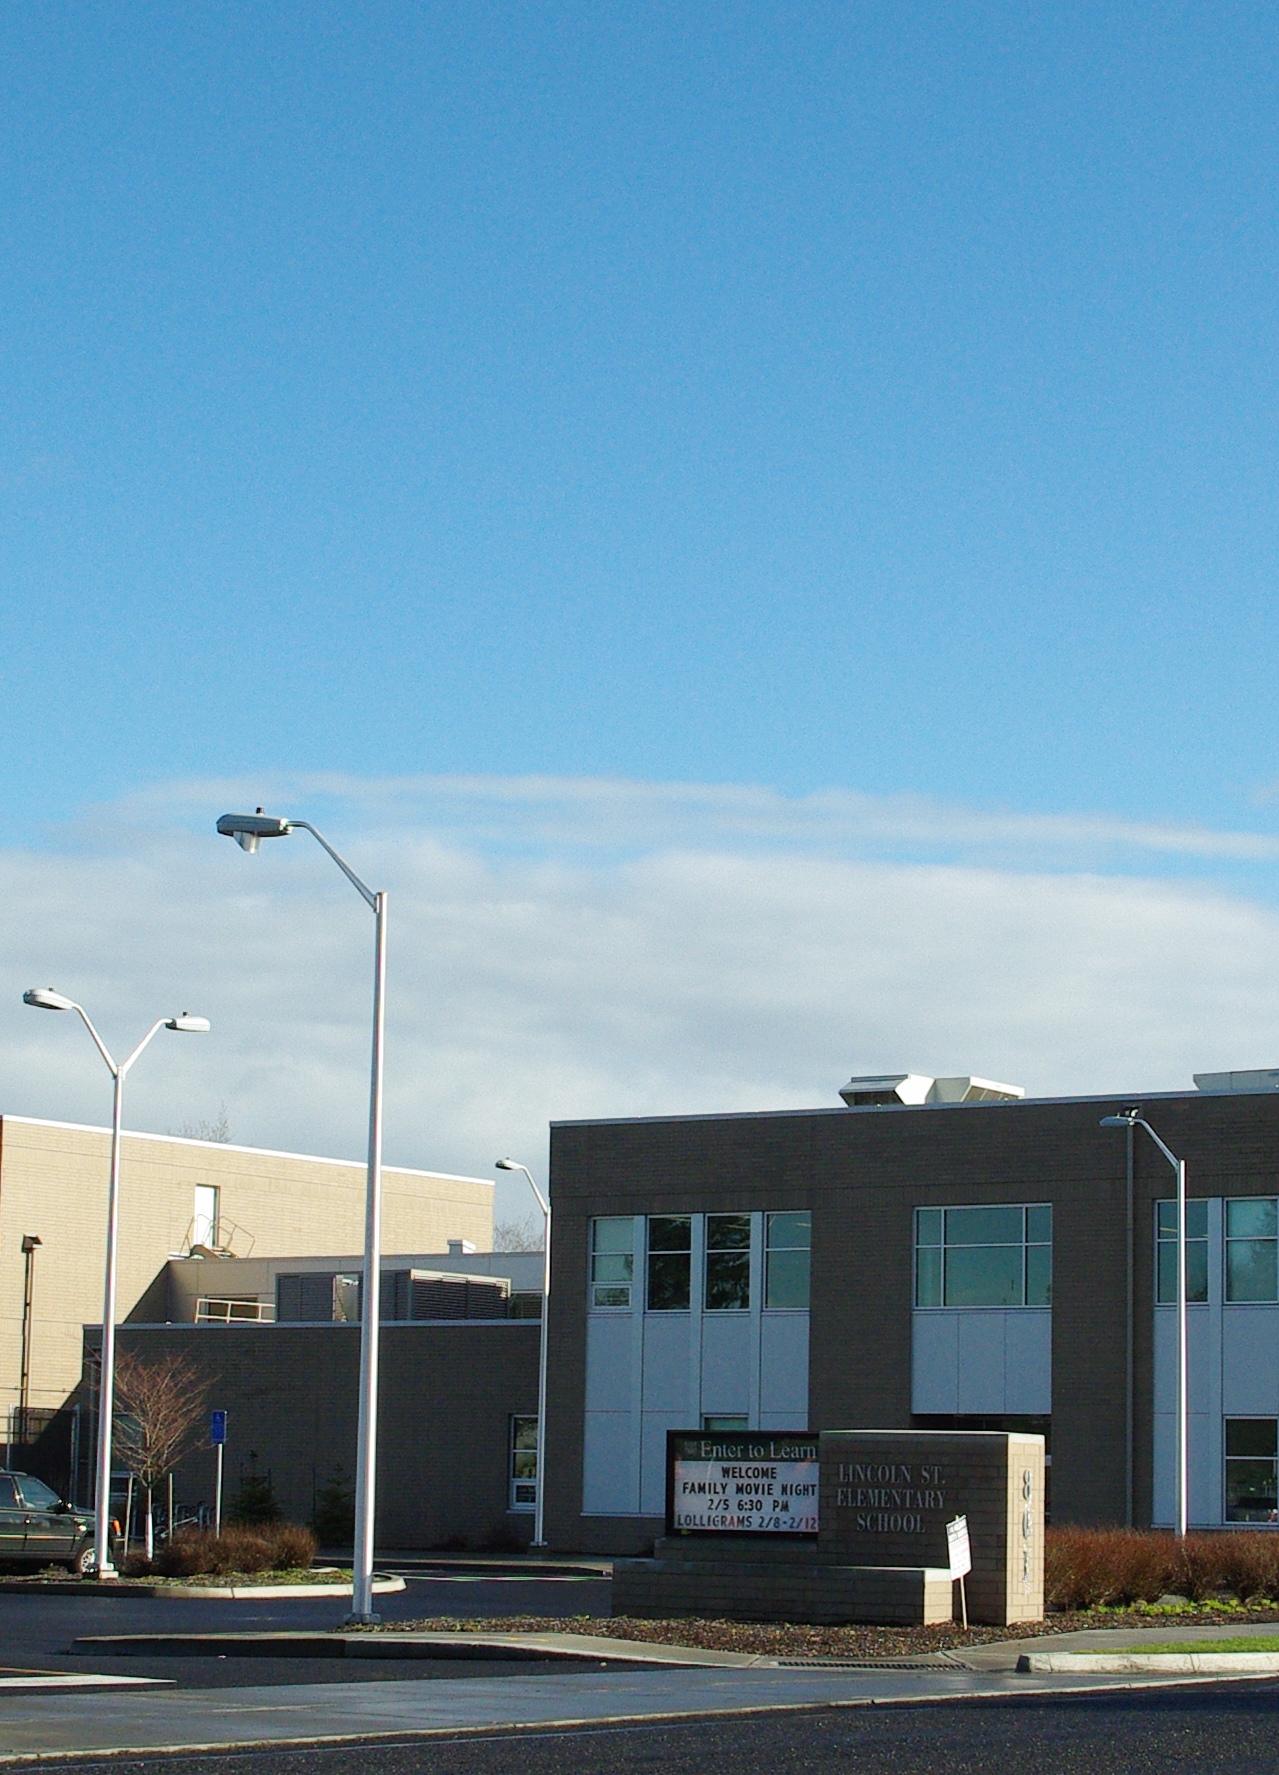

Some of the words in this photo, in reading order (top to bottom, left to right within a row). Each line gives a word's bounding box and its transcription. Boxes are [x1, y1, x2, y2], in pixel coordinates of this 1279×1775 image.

[701, 1440, 744, 1457] Enter
[749, 1444, 764, 1457] to
[770, 1442, 816, 1458] Learn
[722, 1466, 777, 1479] WELCOME
[839, 1464, 911, 1483] LINCOLN
[921, 1466, 946, 1484] ST.
[683, 1482, 727, 1494] FAMILY
[736, 1484, 774, 1495] MOVIE
[781, 1484, 817, 1496] NIGHT
[708, 1499, 729, 1510] 2/5
[737, 1500, 763, 1511] 6:30
[772, 1500, 790, 1512] PM
[837, 1489, 946, 1508] ELEMENTARY
[677, 1514, 753, 1527] LOLLIGRAMS
[856, 1513, 926, 1533] SCHOOL
